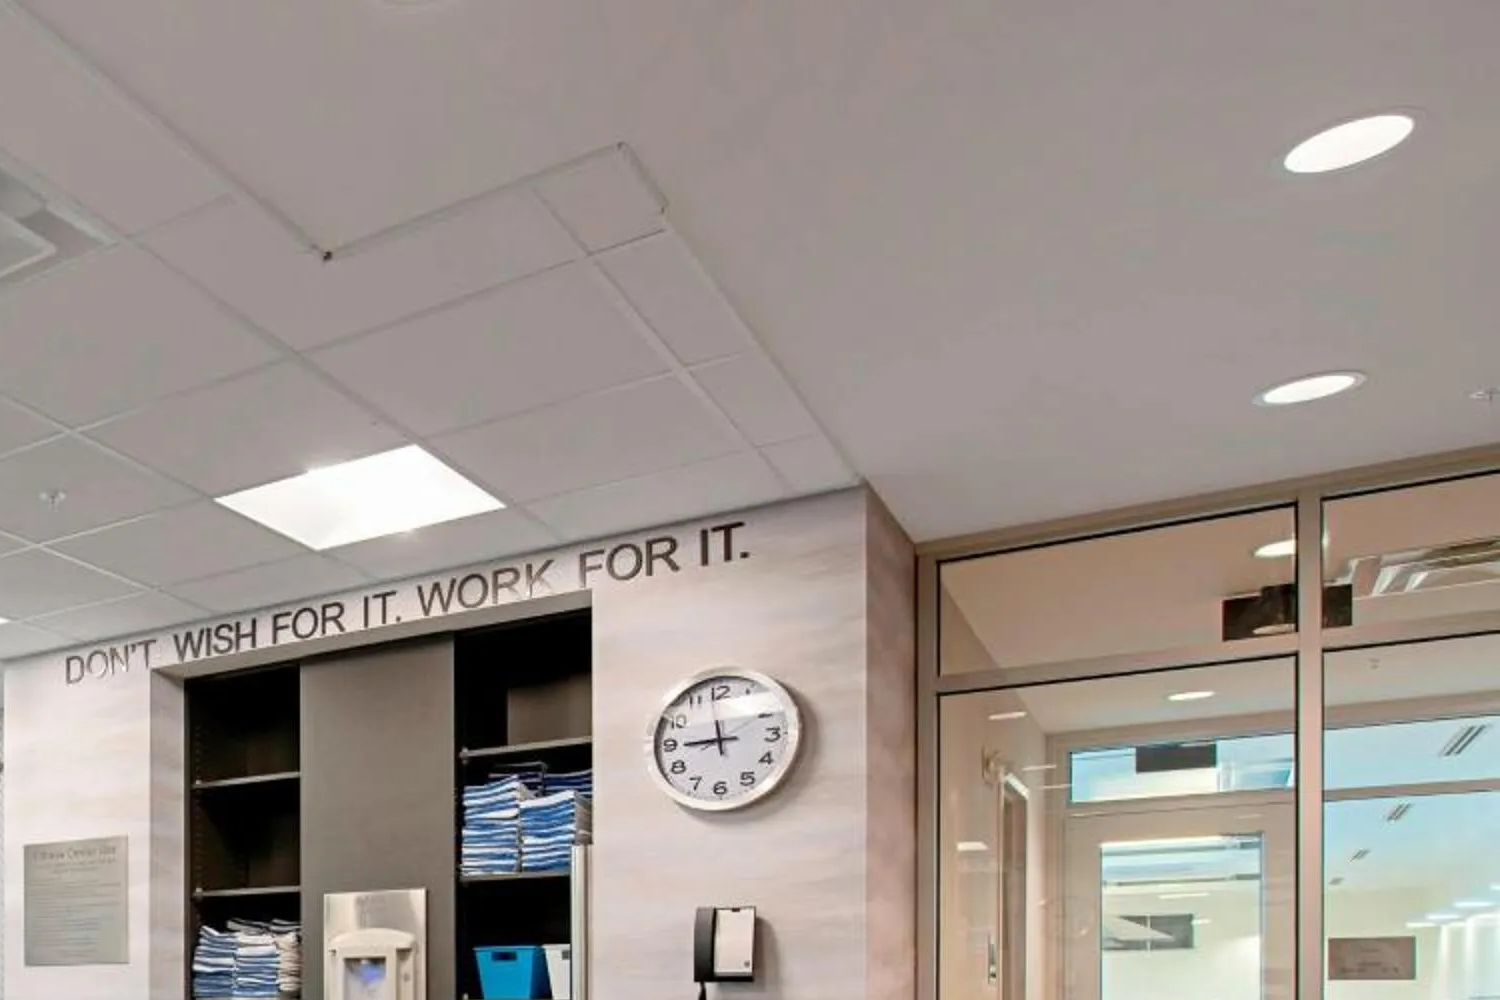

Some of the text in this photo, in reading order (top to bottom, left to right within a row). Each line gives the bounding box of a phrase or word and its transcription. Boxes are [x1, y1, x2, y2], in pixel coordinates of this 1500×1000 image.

[65, 521, 750, 685] DON'T WISH FOR IT. WORK FOR IT.
[711, 685, 732, 701] 12
[669, 713, 687, 730] 10
[763, 727, 781, 743] 3
[663, 738, 678, 753] 9
[758, 751, 774, 765] 4
[670, 759, 687, 775] 8
[689, 775, 703, 791] 7
[739, 771, 756, 787] 5
[712, 781, 728, 795] 6
